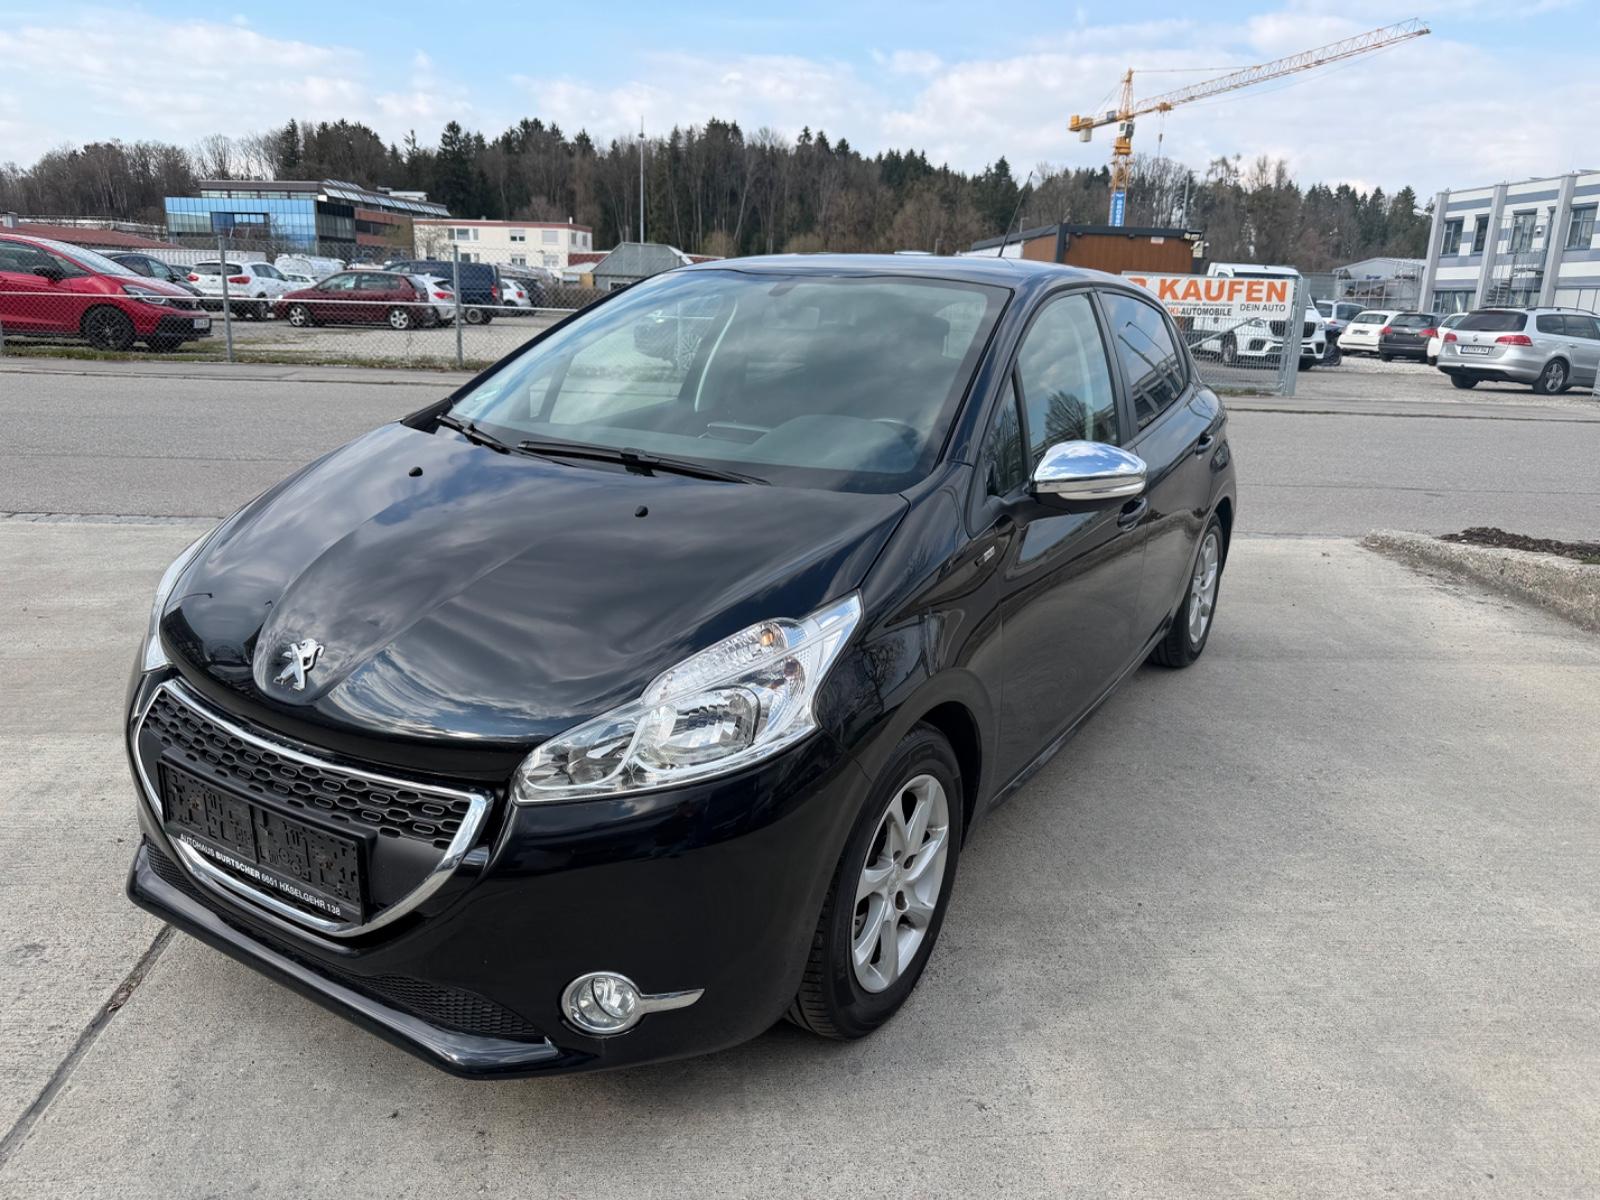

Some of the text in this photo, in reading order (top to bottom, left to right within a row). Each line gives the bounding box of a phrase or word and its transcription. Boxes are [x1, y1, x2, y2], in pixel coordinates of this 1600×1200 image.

[1158, 278, 1287, 303] KAUFEN
[1240, 303, 1260, 311] DEIN
[1262, 303, 1286, 312] AUTO
[180, 833, 215, 857] AUTOHAUS
[215, 851, 260, 880] BURTSCHER
